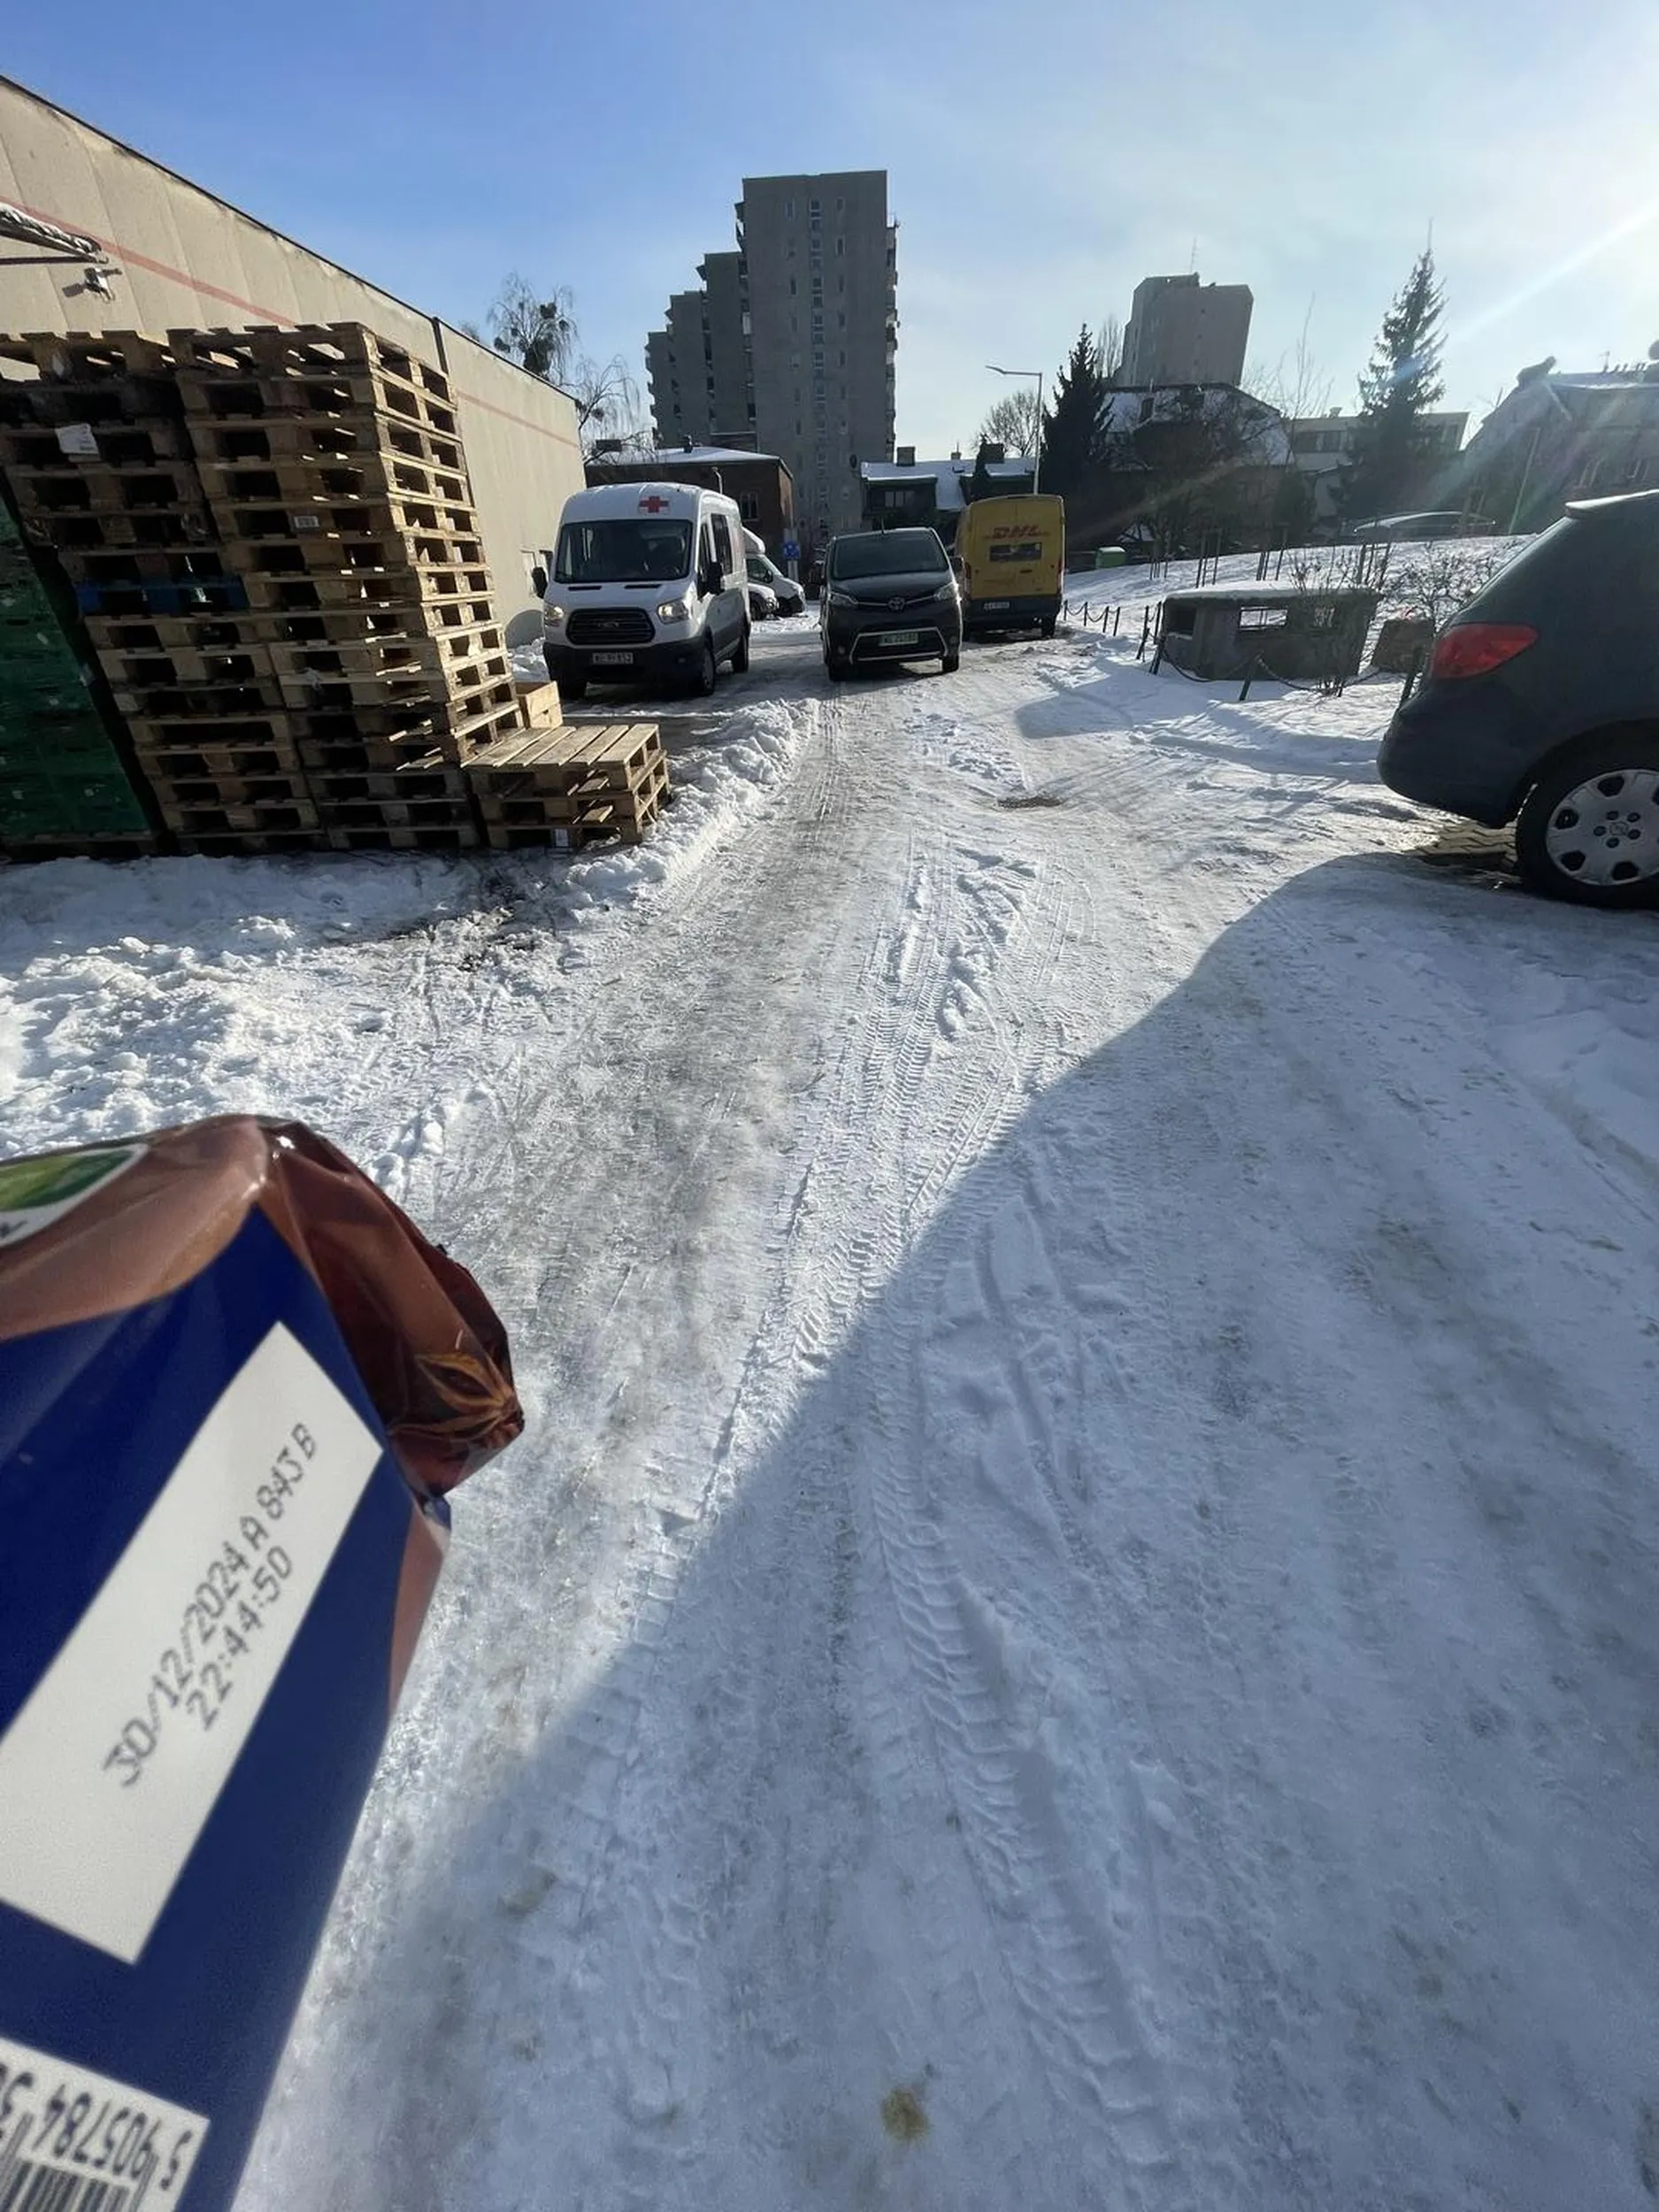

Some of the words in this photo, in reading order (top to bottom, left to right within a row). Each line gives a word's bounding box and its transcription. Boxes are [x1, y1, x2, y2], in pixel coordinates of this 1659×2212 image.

[991, 524, 1041, 539] DHL
[103, 1540, 250, 1786] 30/12/2024
[240, 1517, 269, 1550] A
[257, 1445, 304, 1521] 843
[291, 1423, 316, 1460] B
[186, 1545, 292, 1732] 22:44:50
[31, 2083, 161, 2180] 905784
[159, 2129, 193, 2192] 5
